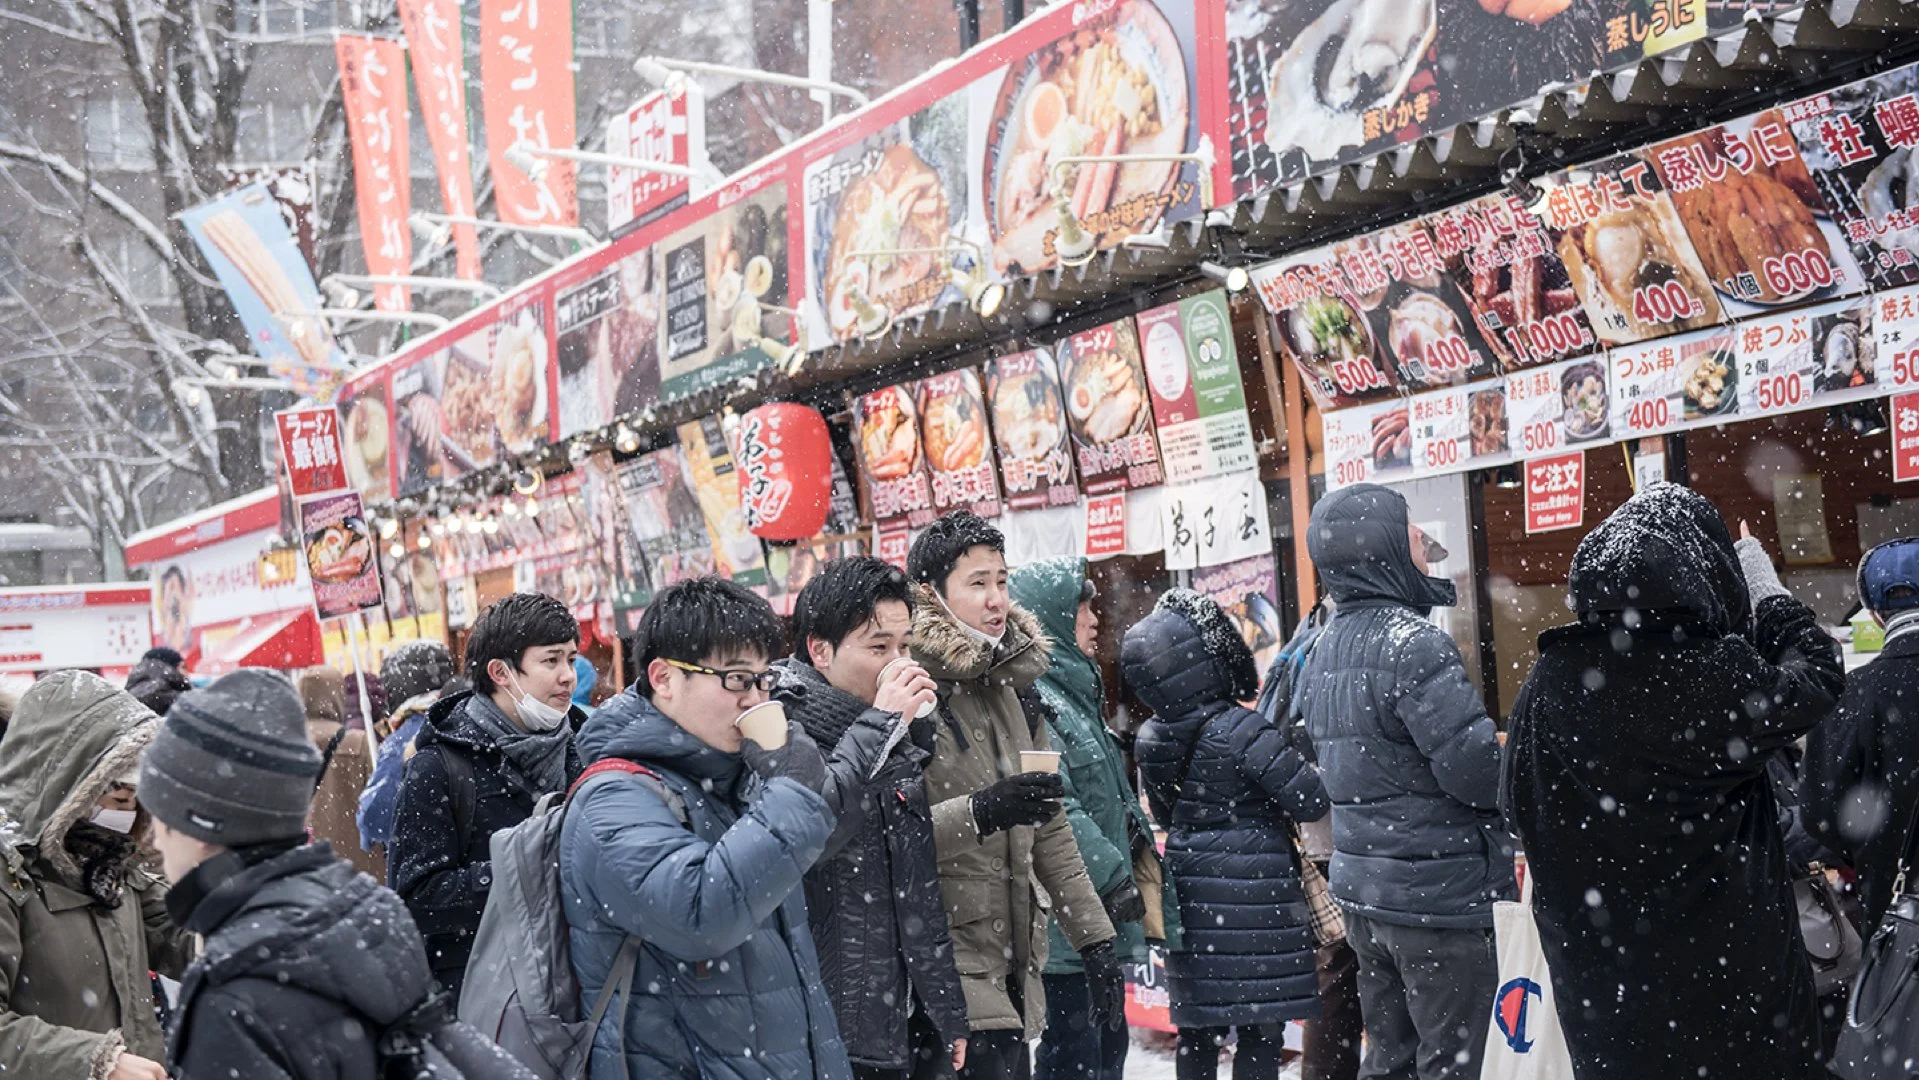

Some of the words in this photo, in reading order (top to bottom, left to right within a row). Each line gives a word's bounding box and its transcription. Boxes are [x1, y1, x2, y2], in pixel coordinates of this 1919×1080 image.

[1605, 0, 1696, 53] 蒸しうに
[1361, 92, 1431, 141] 蒸しかき
[1660, 123, 1794, 193] 蒸しうに
[1548, 163, 1655, 229] 焼ほたて
[1436, 197, 1538, 254] 焼かに足
[1344, 231, 1445, 294] 焼ほっき貝
[1764, 249, 1846, 294] 600円
[1635, 281, 1703, 322] 400円
[1882, 294, 1919, 322] 焼え
[1075, 330, 1111, 356] ラーメン
[1743, 317, 1806, 353] 焼つぶ
[1882, 331, 1901, 344] 2本
[1002, 354, 1035, 377] ラーメン
[1617, 347, 1674, 378] つぶ串
[1745, 359, 1769, 375] 2個
[864, 391, 895, 411] ラーメン
[928, 375, 961, 398] ラーメン
[1759, 374, 1810, 409] 500円
[1414, 395, 1463, 420] 焼おにぎり
[1630, 398, 1676, 430] 400円
[286, 412, 331, 439] ラーメン
[1531, 460, 1579, 493] ご注文
[1537, 515, 1555, 525] Order
[1556, 512, 1572, 522] Here
